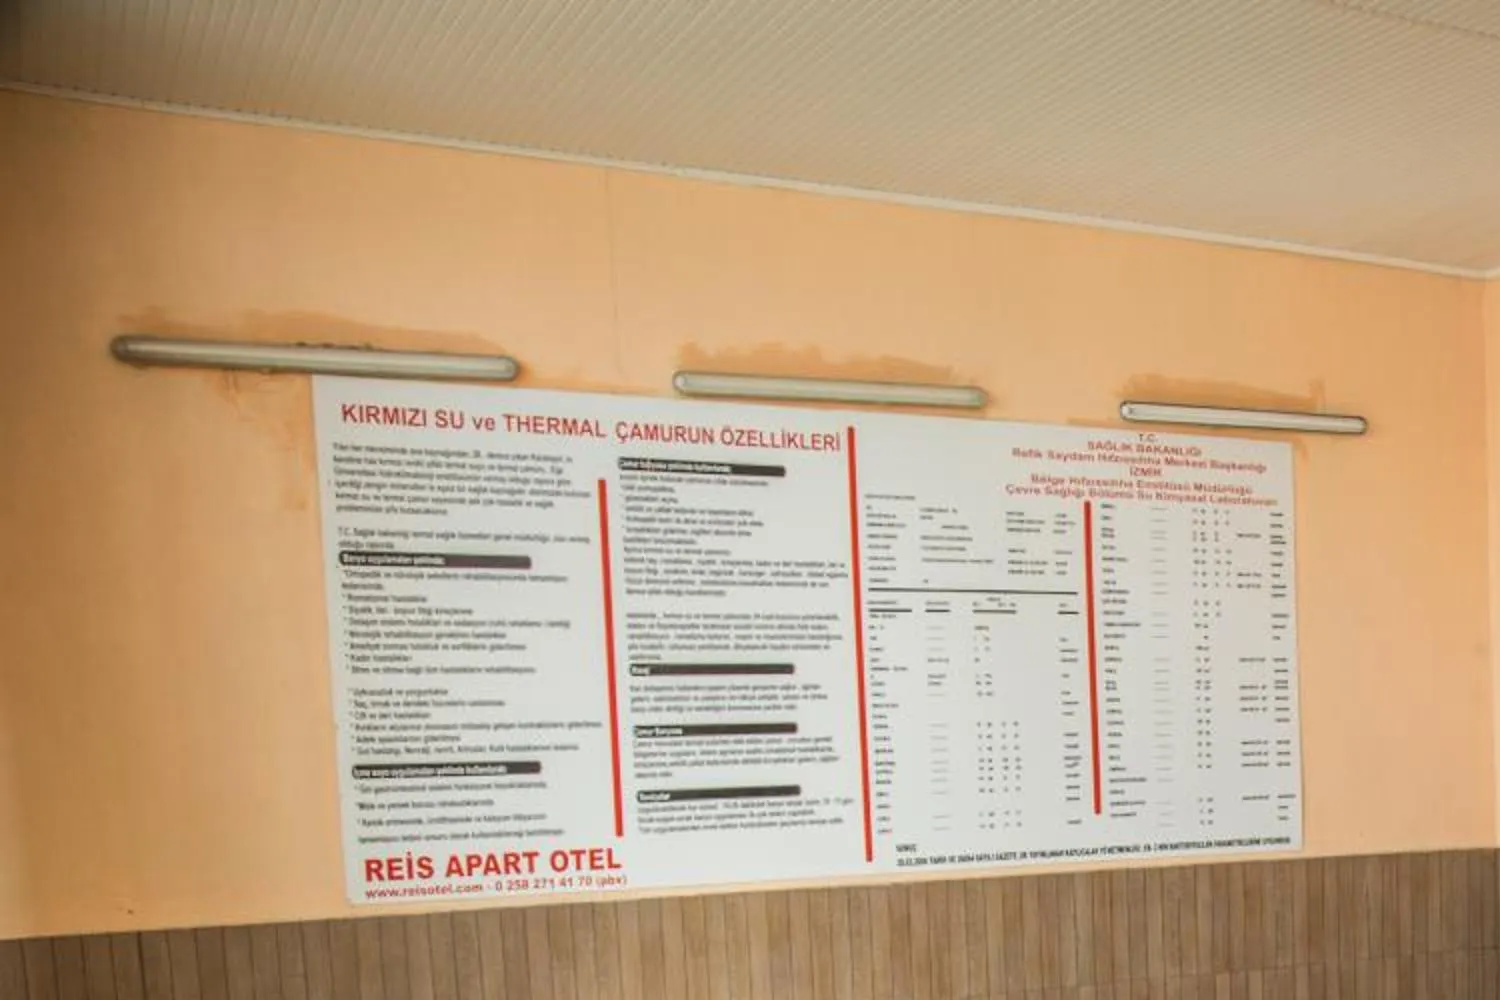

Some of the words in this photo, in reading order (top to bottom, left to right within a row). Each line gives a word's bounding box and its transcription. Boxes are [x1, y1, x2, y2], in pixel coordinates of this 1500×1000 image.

[341, 403, 428, 427] KIRMIZI
[435, 408, 465, 430] SU
[471, 415, 496, 431] ve
[502, 413, 607, 439] THERMAL
[615, 421, 715, 445] ÇAMURUN
[720, 425, 841, 451] ÖZELLİKLERİ
[364, 851, 435, 883] REİS
[444, 851, 540, 878] APART
[549, 848, 622, 873] OTEL
[364, 883, 483, 899] www.reisotel.com
[507, 879, 529, 891] 258
